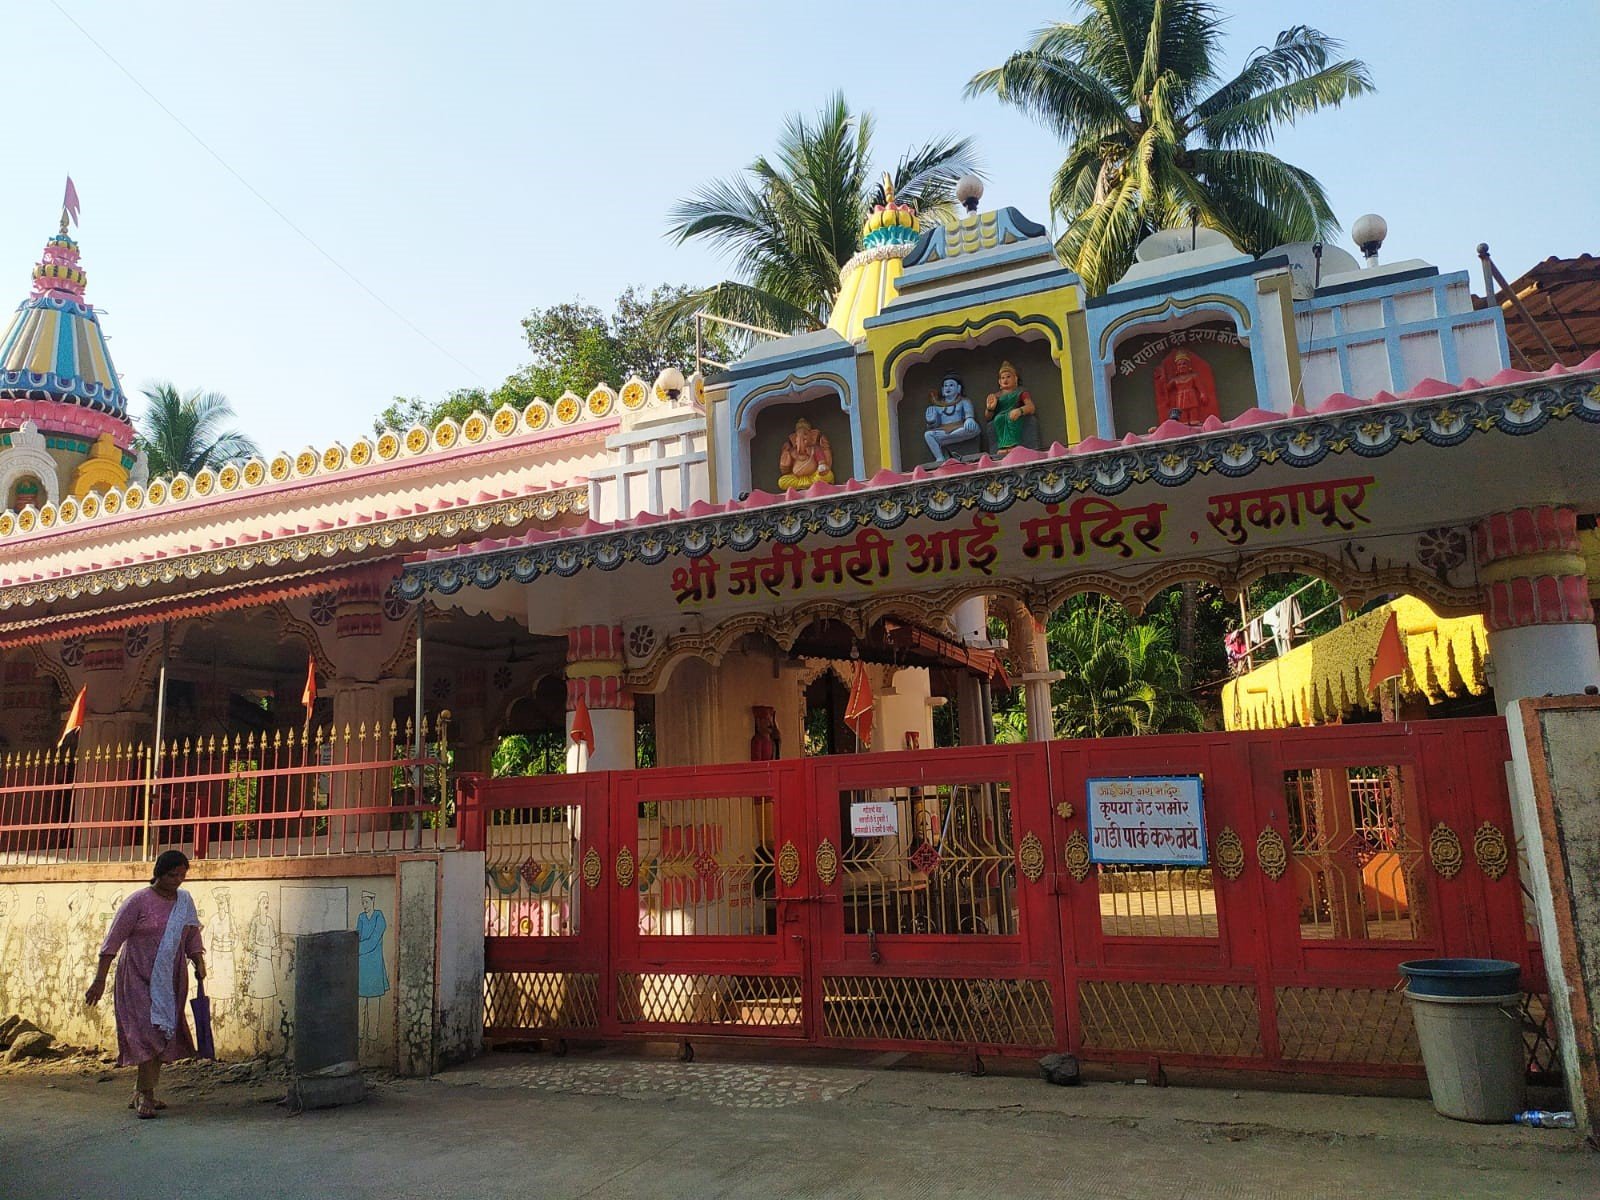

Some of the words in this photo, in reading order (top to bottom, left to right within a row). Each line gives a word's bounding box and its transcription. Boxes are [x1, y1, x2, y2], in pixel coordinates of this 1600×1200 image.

[1119, 358, 1136, 376] श्री
[1133, 337, 1169, 365] राघोबा
[1169, 331, 1188, 346] देव
[671, 552, 721, 605] श्री
[905, 513, 1000, 575] आई
[1020, 497, 1168, 559] मंदिर
[1206, 475, 1375, 545] सुकापूर
[1099, 801, 1133, 820] कृपया
[1135, 799, 1153, 816] गेट
[1155, 798, 1189, 816] समोर
[1094, 821, 1122, 848] गाडी
[1122, 821, 1149, 849] पार्क
